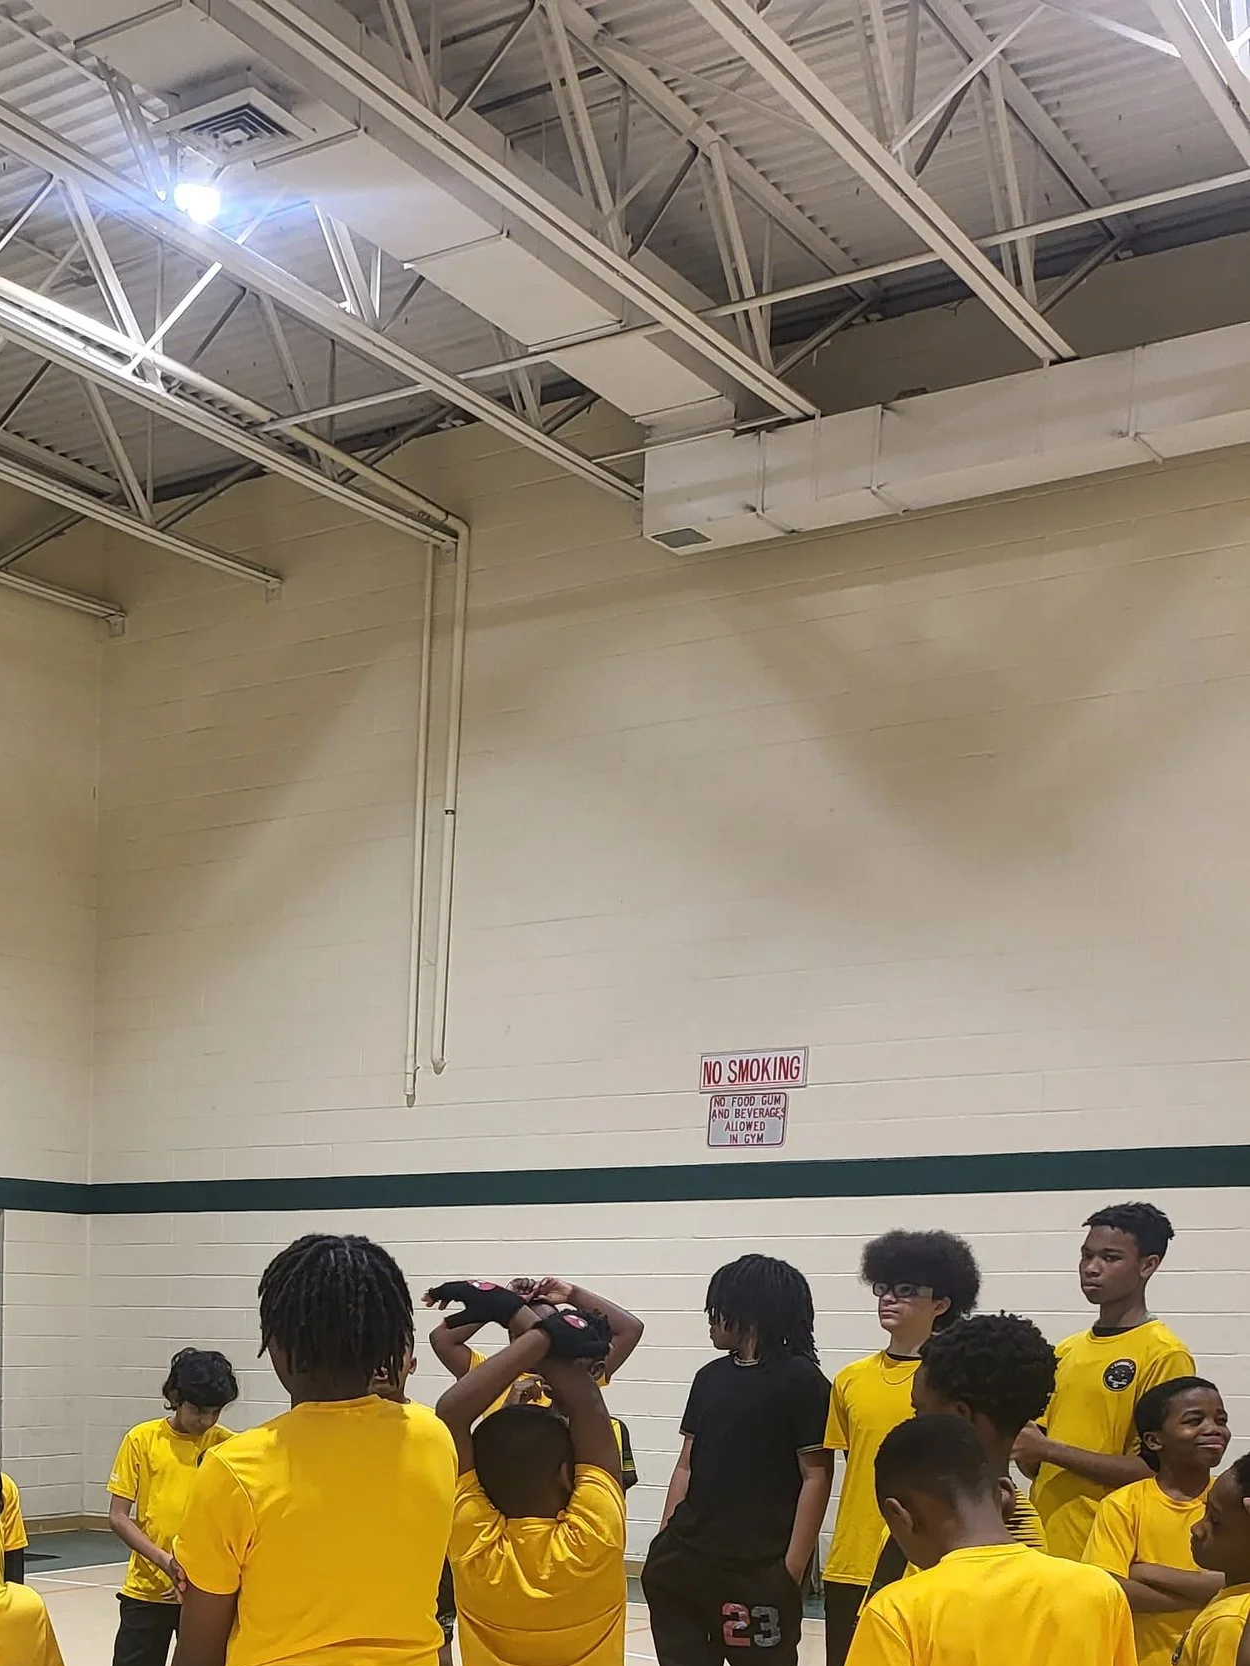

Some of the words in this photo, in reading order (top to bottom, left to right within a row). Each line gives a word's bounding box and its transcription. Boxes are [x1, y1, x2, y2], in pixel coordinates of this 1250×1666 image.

[703, 1060, 722, 1085] NO
[727, 1056, 801, 1084] SMOKING
[714, 1096, 726, 1107] NO
[731, 1096, 756, 1107] FOOD
[761, 1095, 781, 1106] GUM
[711, 1108, 730, 1120] AND
[734, 1107, 785, 1119] BEVERAGES
[725, 1120, 766, 1132] ALLOWED
[729, 1134, 738, 1144] IN
[744, 1133, 764, 1144] GYM
[721, 1602, 782, 1648] 23
